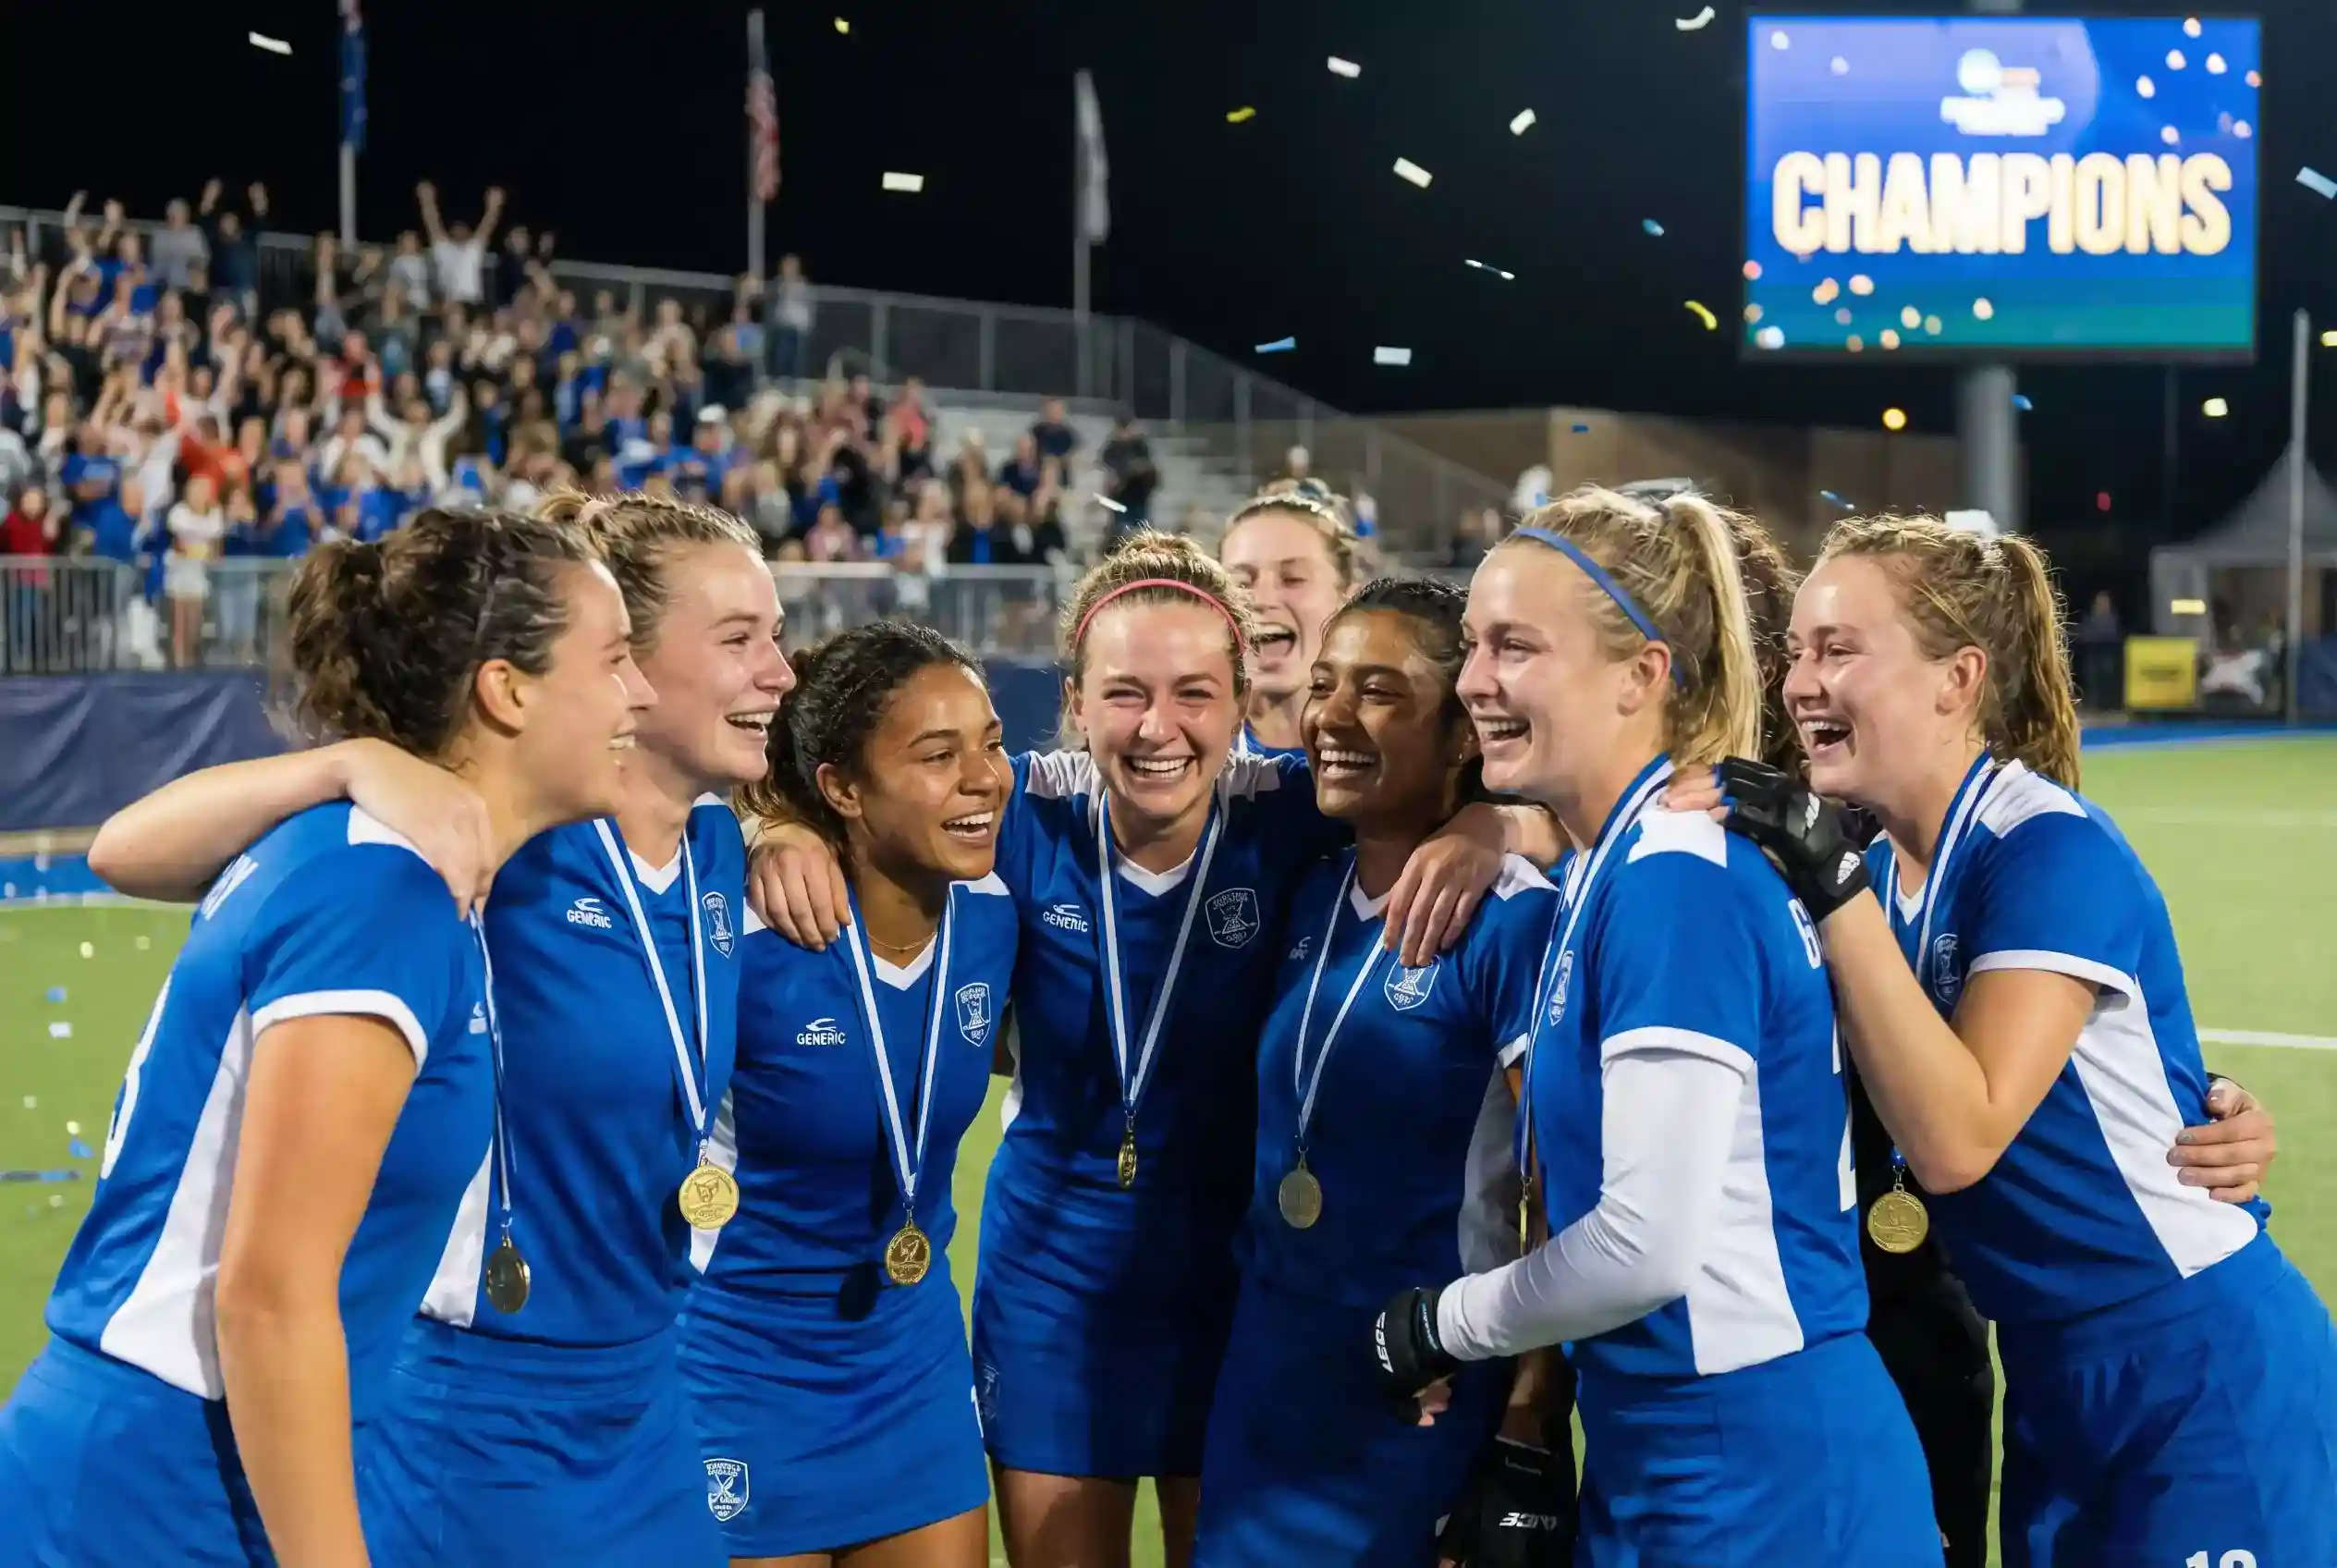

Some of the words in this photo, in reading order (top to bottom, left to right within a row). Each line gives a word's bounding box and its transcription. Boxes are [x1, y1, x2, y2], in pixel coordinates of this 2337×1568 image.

[1772, 151, 2233, 256] CHAMPIONS
[1043, 911, 1088, 933] GENERIC
[796, 1031, 846, 1046] GENERIC
